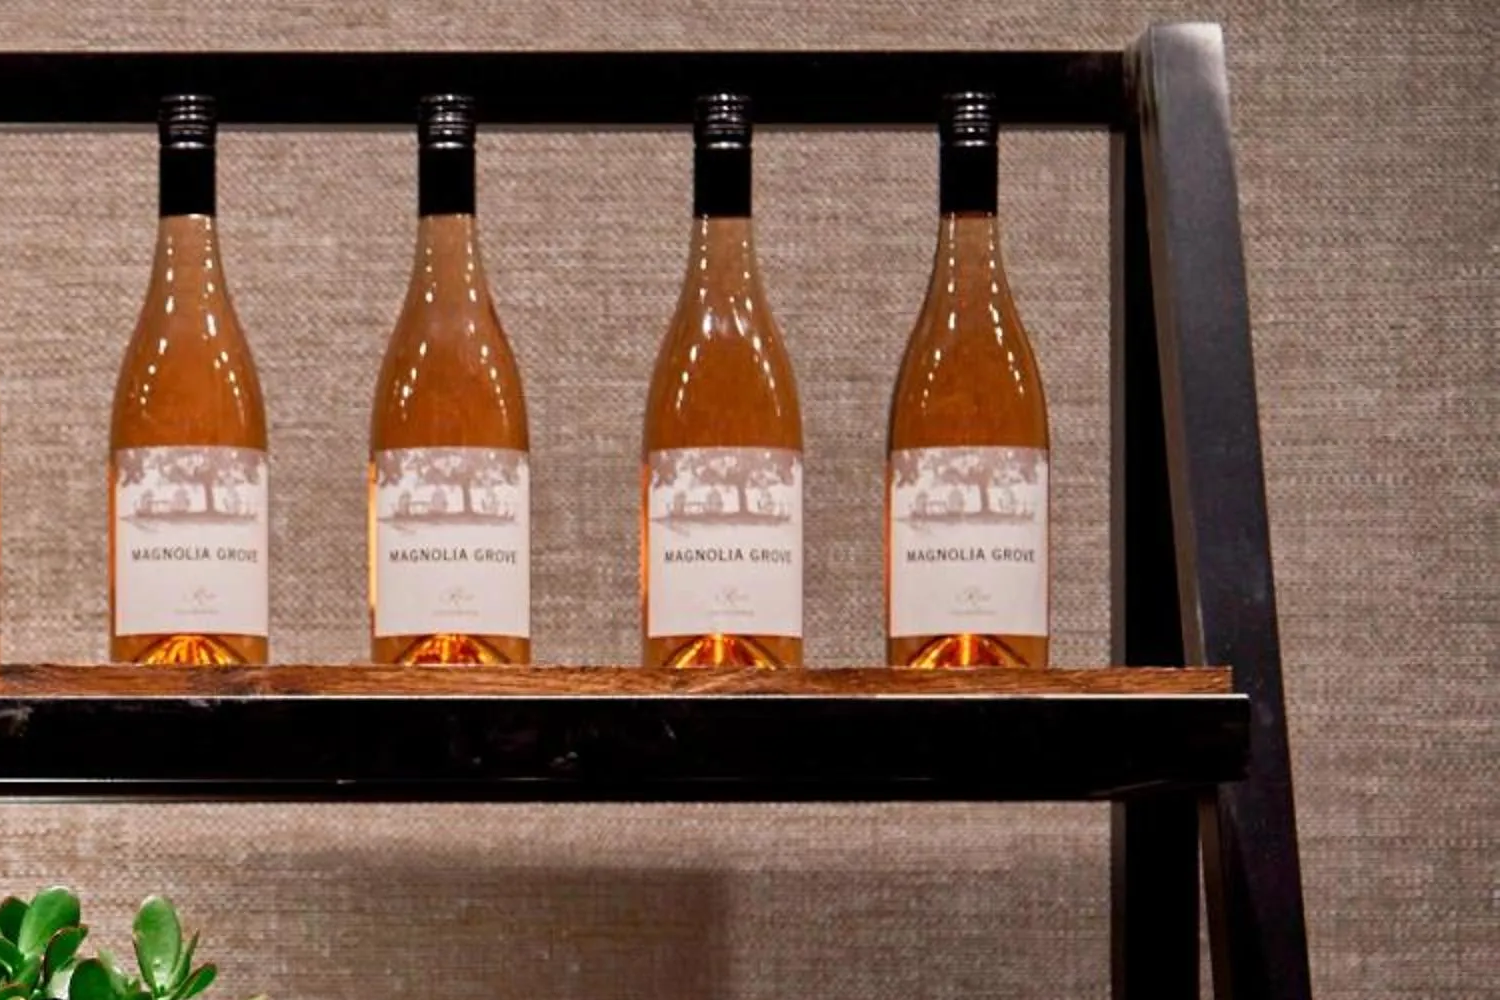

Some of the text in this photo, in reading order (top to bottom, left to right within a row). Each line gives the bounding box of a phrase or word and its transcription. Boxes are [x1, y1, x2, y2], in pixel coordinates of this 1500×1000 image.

[131, 546, 258, 564] MAGNOLIA GROVE
[389, 547, 517, 564] MAGNOLIA GROVE
[663, 547, 792, 564] MAGNOLIA GROVE
[906, 547, 1035, 563] MAGNOLIA GROVE
